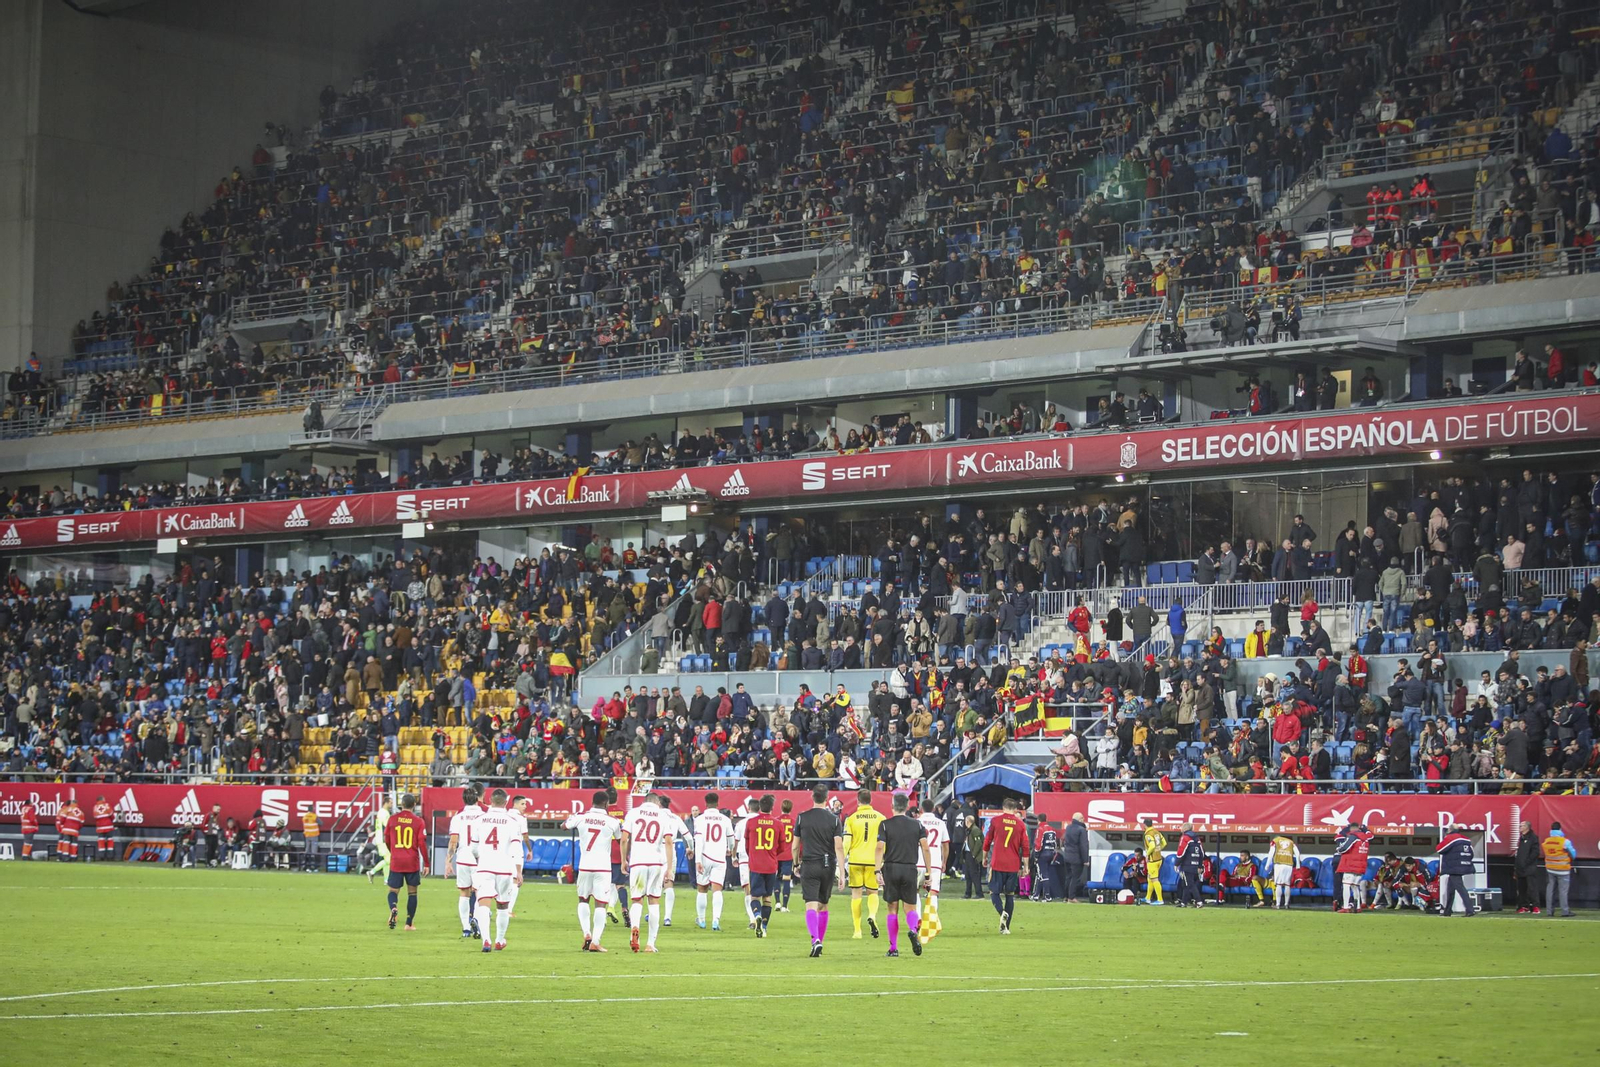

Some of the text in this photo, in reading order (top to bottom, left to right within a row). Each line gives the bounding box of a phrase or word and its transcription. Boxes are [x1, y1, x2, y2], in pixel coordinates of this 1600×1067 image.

[1161, 404, 1588, 463] SELECCIÓN ESPAÑOLA DE FÚTBOL
[980, 449, 1062, 473] CaixaBank
[832, 464, 891, 480] SEAT
[544, 484, 610, 505] CaiBank
[720, 486, 750, 497] adidas
[420, 497, 470, 511] SEAT
[78, 521, 120, 535] SEAT
[180, 512, 236, 530] CaixaBank
[284, 518, 309, 529] adidas
[329, 514, 354, 525] adidas
[297, 800, 370, 818] SEAT
[640, 809, 659, 818] PISANI
[482, 817, 508, 826] MICALLEF
[585, 817, 606, 827] MBONG
[758, 818, 774, 826] GERARD
[395, 825, 414, 849] 10
[485, 827, 499, 850] 4
[586, 828, 601, 852] 7
[635, 818, 660, 845] 20
[705, 823, 722, 843] 10
[755, 827, 775, 850] 19
[864, 822, 869, 843] 1
[926, 828, 939, 848] 2
[1004, 826, 1014, 848] 7
